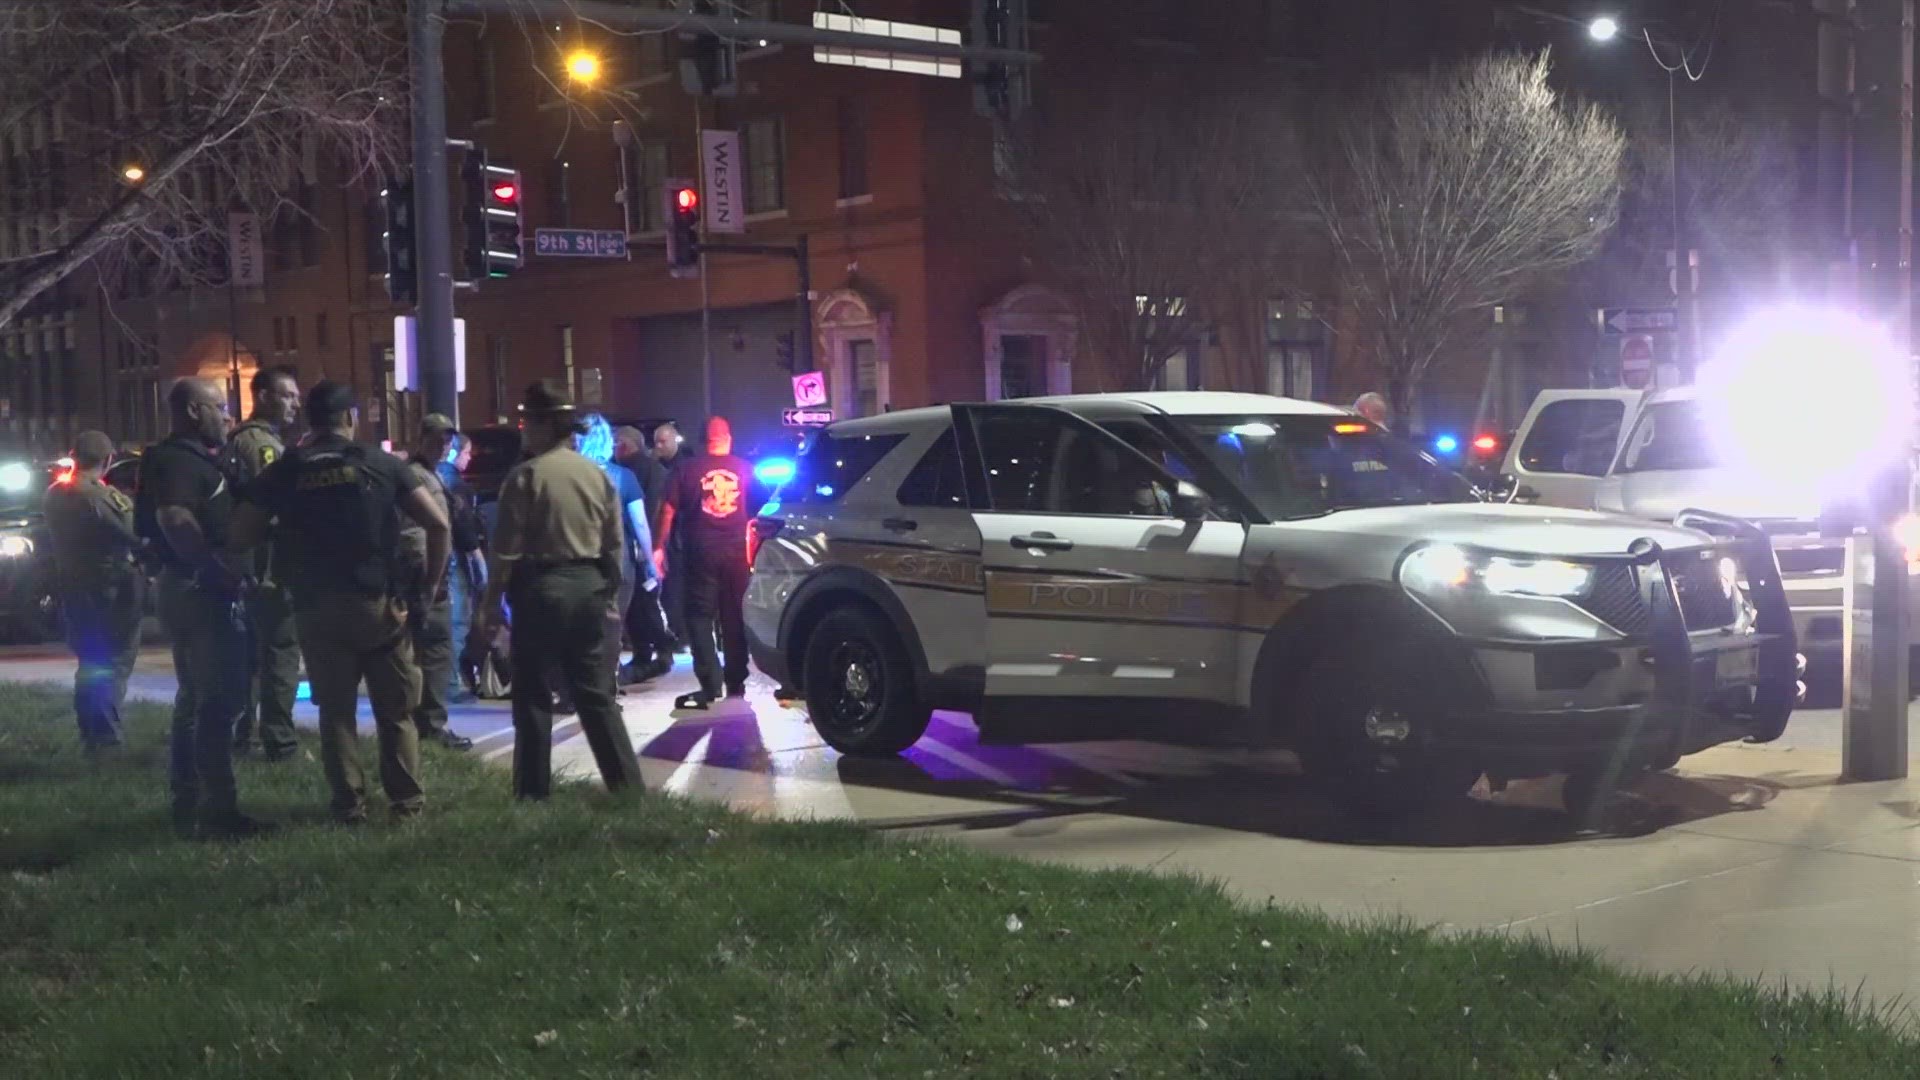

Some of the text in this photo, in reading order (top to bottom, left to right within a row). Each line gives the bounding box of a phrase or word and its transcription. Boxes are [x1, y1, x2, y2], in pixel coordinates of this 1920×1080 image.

[713, 141, 730, 223] WESTIN
[240, 220, 251, 279] WESTIN
[540, 234, 568, 251] 9th
[576, 235, 593, 251] St
[897, 554, 984, 584] STATE
[1030, 584, 1206, 613] POLICE
